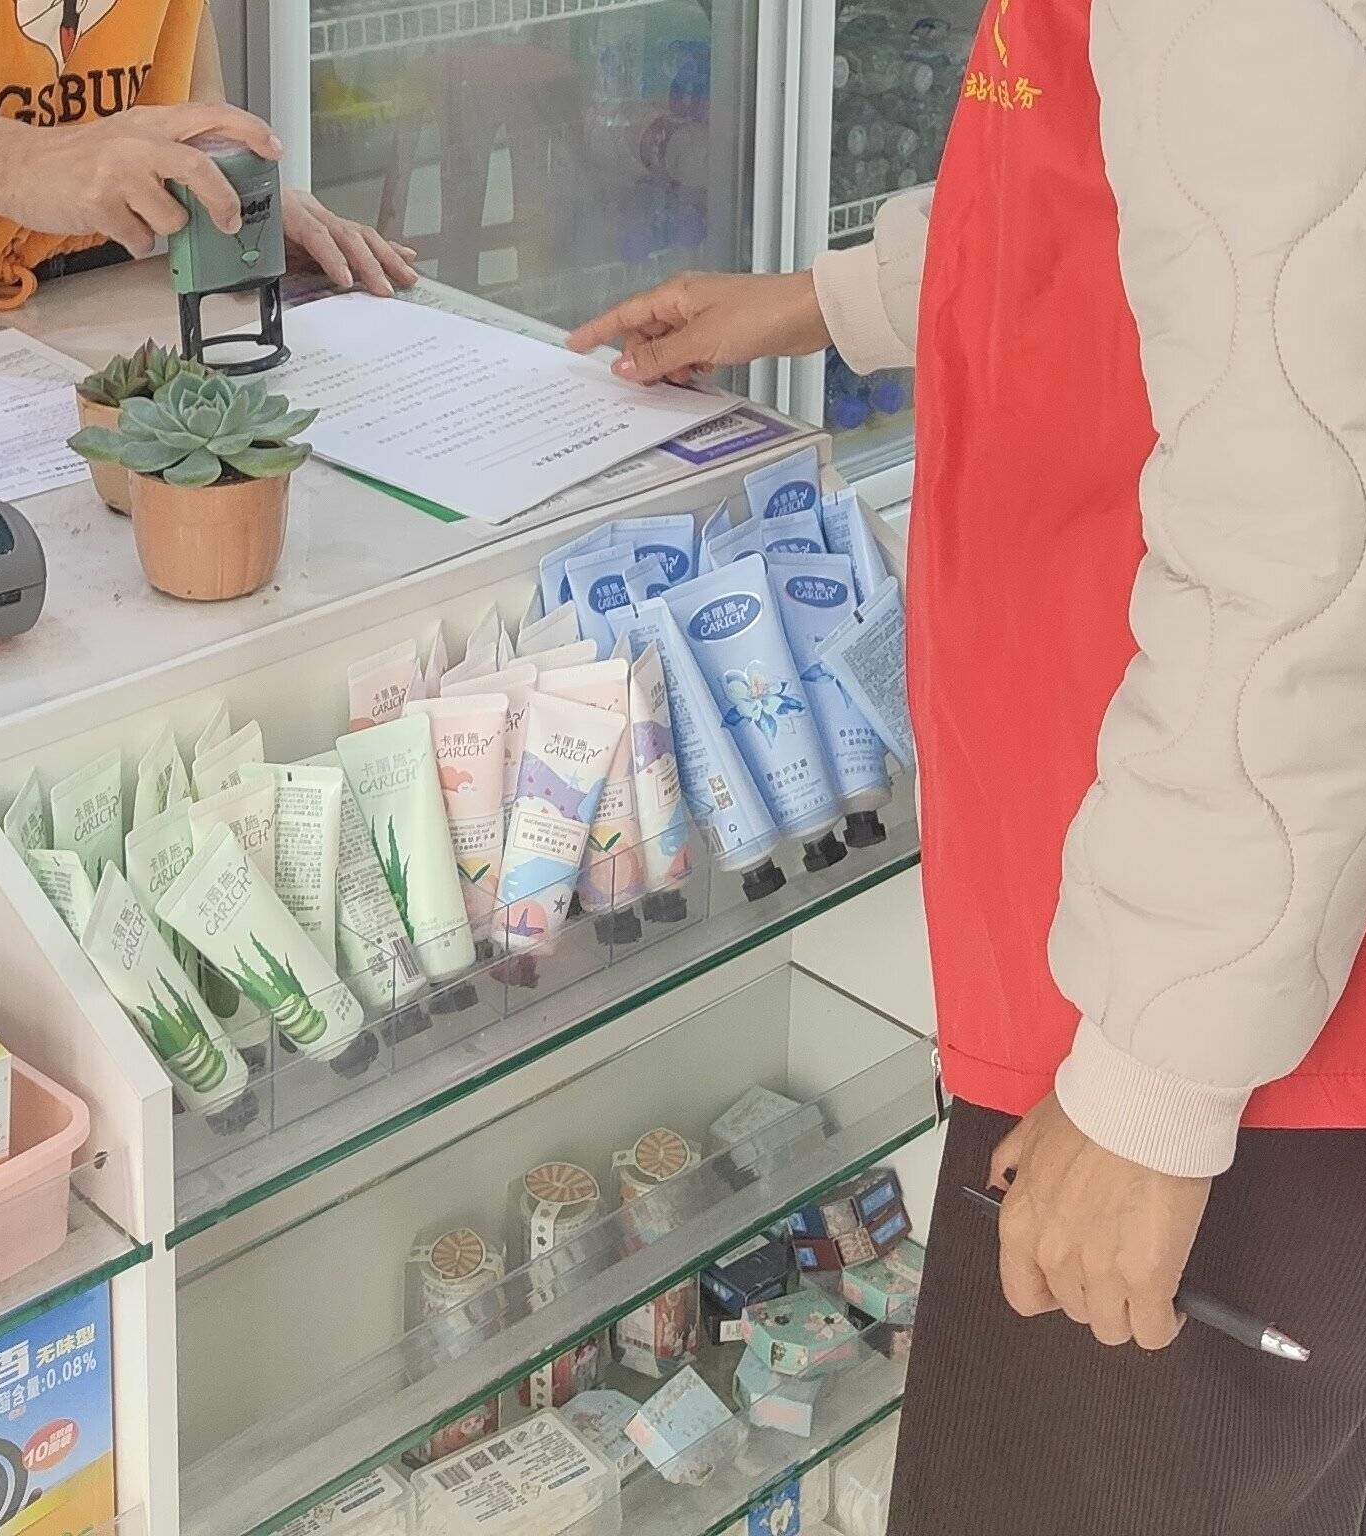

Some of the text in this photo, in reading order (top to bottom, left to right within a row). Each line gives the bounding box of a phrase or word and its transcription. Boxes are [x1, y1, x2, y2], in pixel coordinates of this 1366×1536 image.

[700, 600, 750, 637] CARICH
[436, 736, 494, 760] CARICH
[543, 744, 602, 764] CARICH
[220, 770, 242, 791] 卡丽
[358, 754, 426, 796] CARICH
[73, 792, 122, 842] CARICH
[205, 856, 252, 937] CARICH
[122, 902, 147, 971] CARICH
[36, 1323, 96, 1370] 无味型
